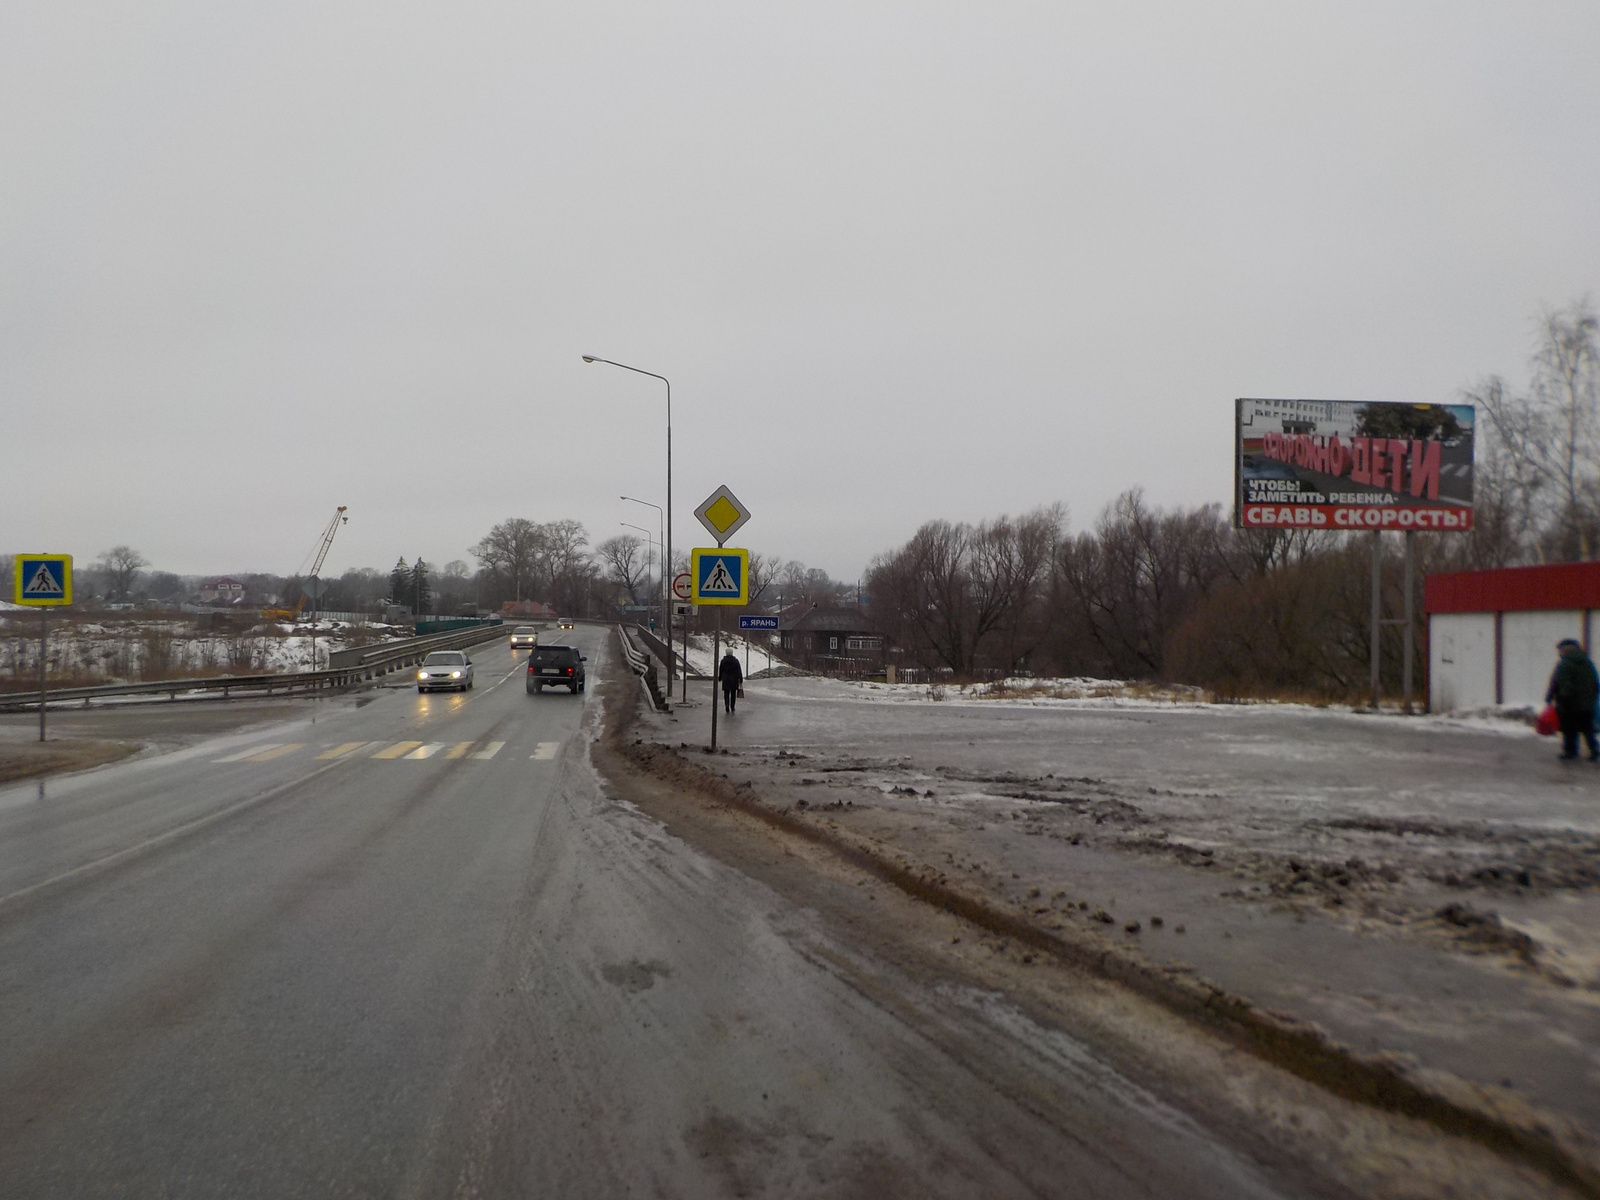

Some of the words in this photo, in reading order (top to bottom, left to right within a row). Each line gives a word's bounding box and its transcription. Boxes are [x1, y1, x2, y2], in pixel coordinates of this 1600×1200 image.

[1351, 436, 1441, 501] ДЕТИ
[1249, 480, 1300, 491] ЧТОБЫ
[1248, 491, 1325, 503] ЗАМЕТИТЬ
[1247, 507, 1326, 524] СБАВЬ
[1335, 508, 1467, 526] СКОРОСТЬ!
